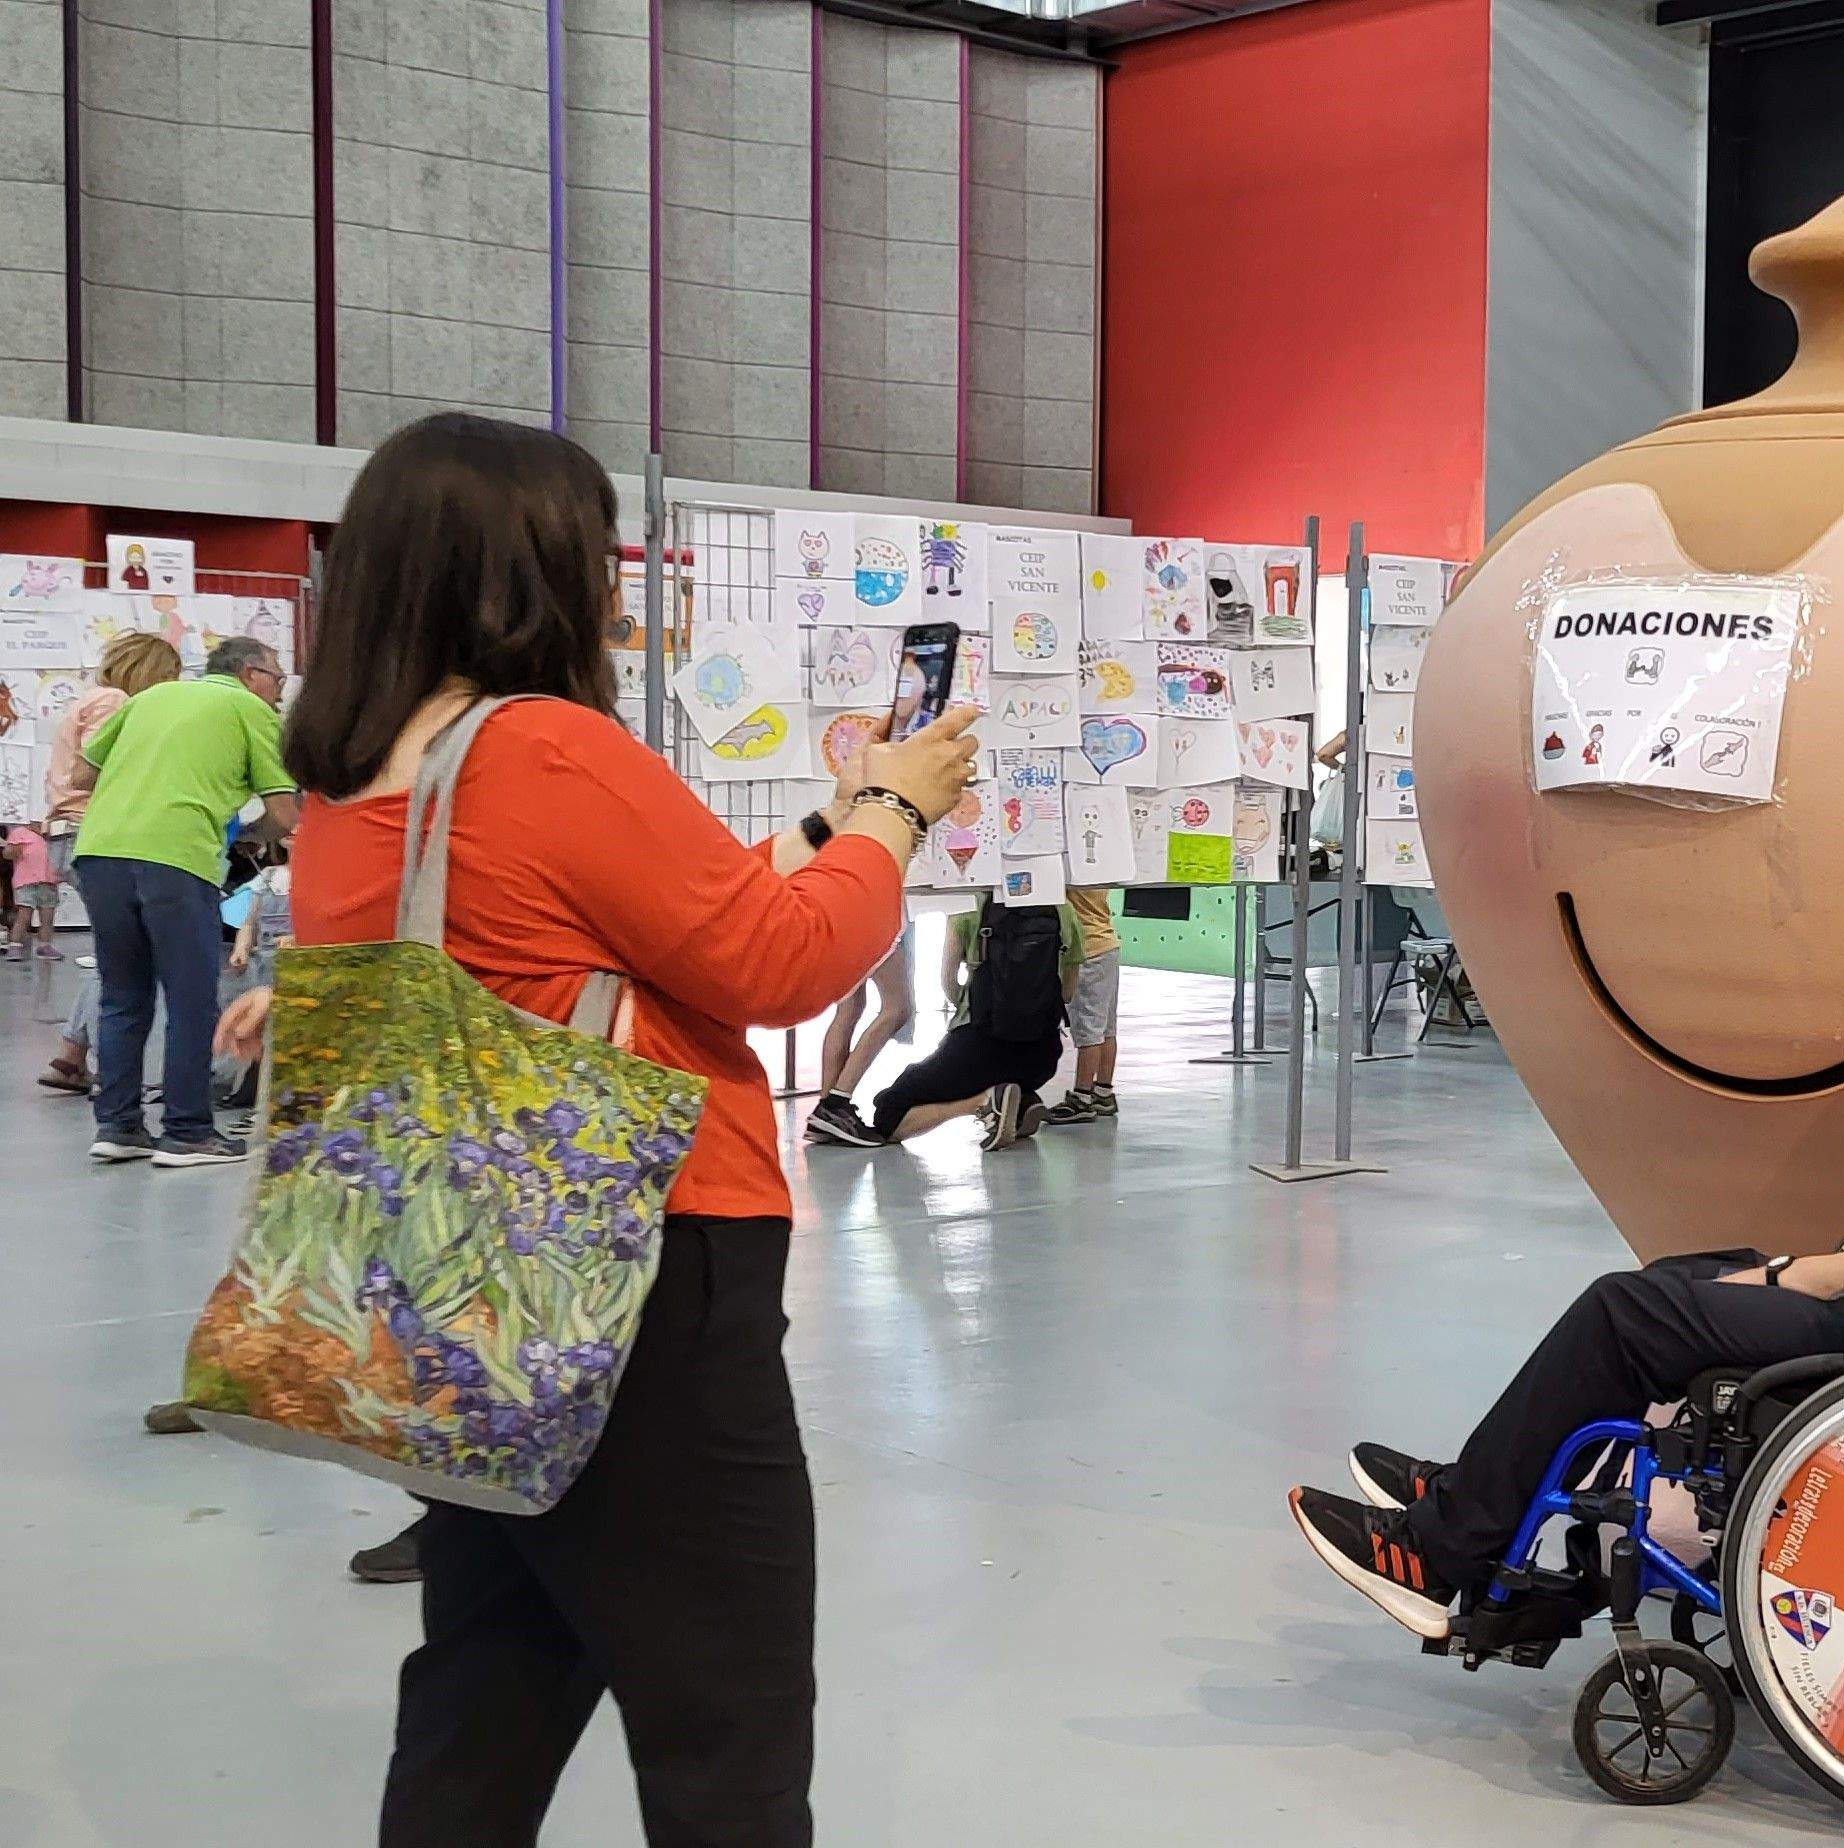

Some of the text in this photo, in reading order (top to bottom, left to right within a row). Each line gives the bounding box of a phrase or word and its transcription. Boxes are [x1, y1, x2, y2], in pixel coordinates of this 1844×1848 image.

[1020, 567, 1045, 578] SAN
[1008, 580, 1061, 594] VICENTE
[1554, 611, 1774, 641] DONACIONES
